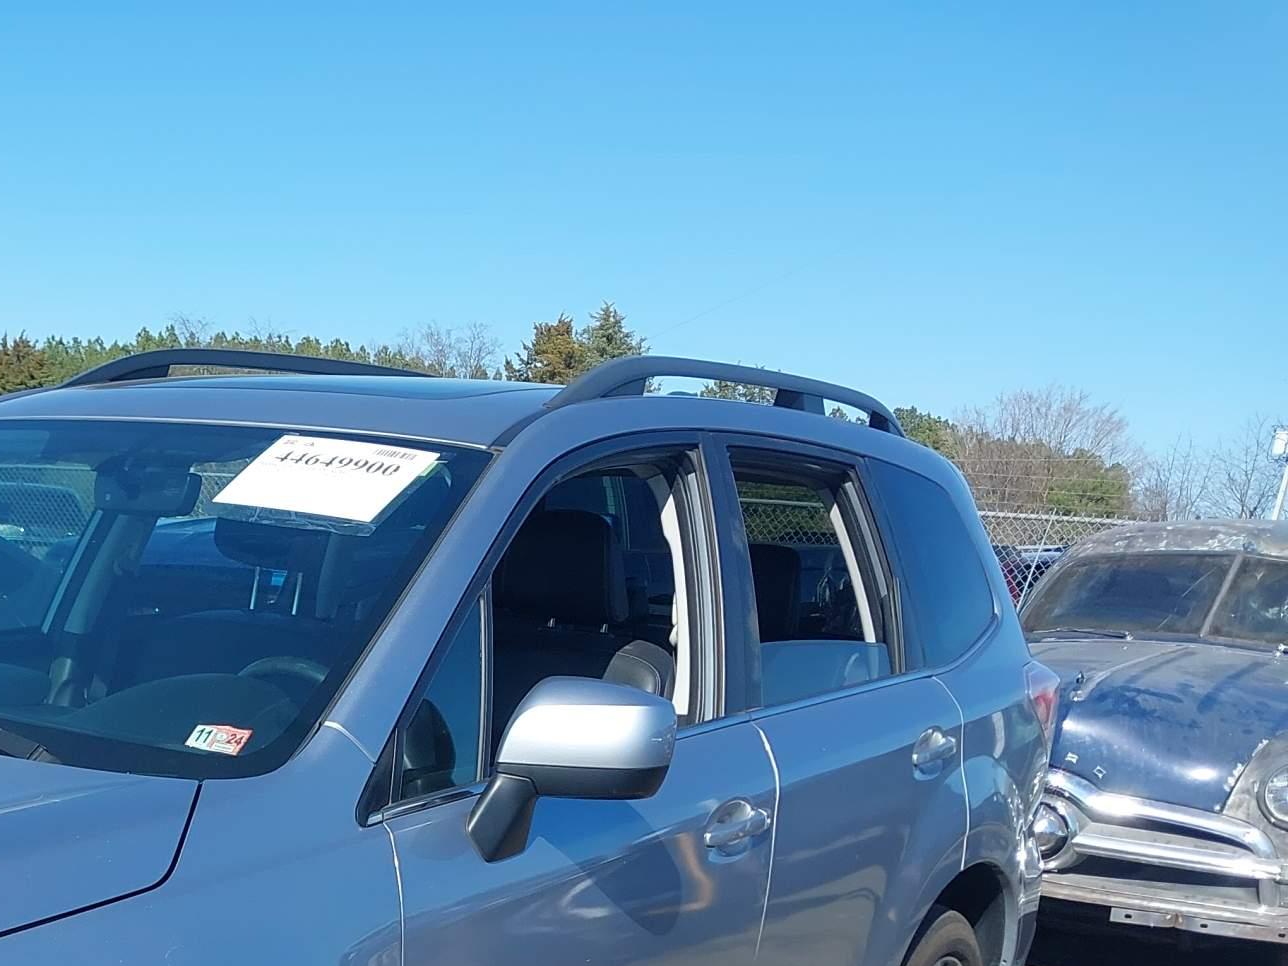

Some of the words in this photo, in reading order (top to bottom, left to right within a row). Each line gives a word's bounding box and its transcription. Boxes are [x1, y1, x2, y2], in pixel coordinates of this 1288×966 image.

[274, 450, 401, 477] 44649900
[195, 727, 214, 744] 11
[226, 733, 245, 746] 24
